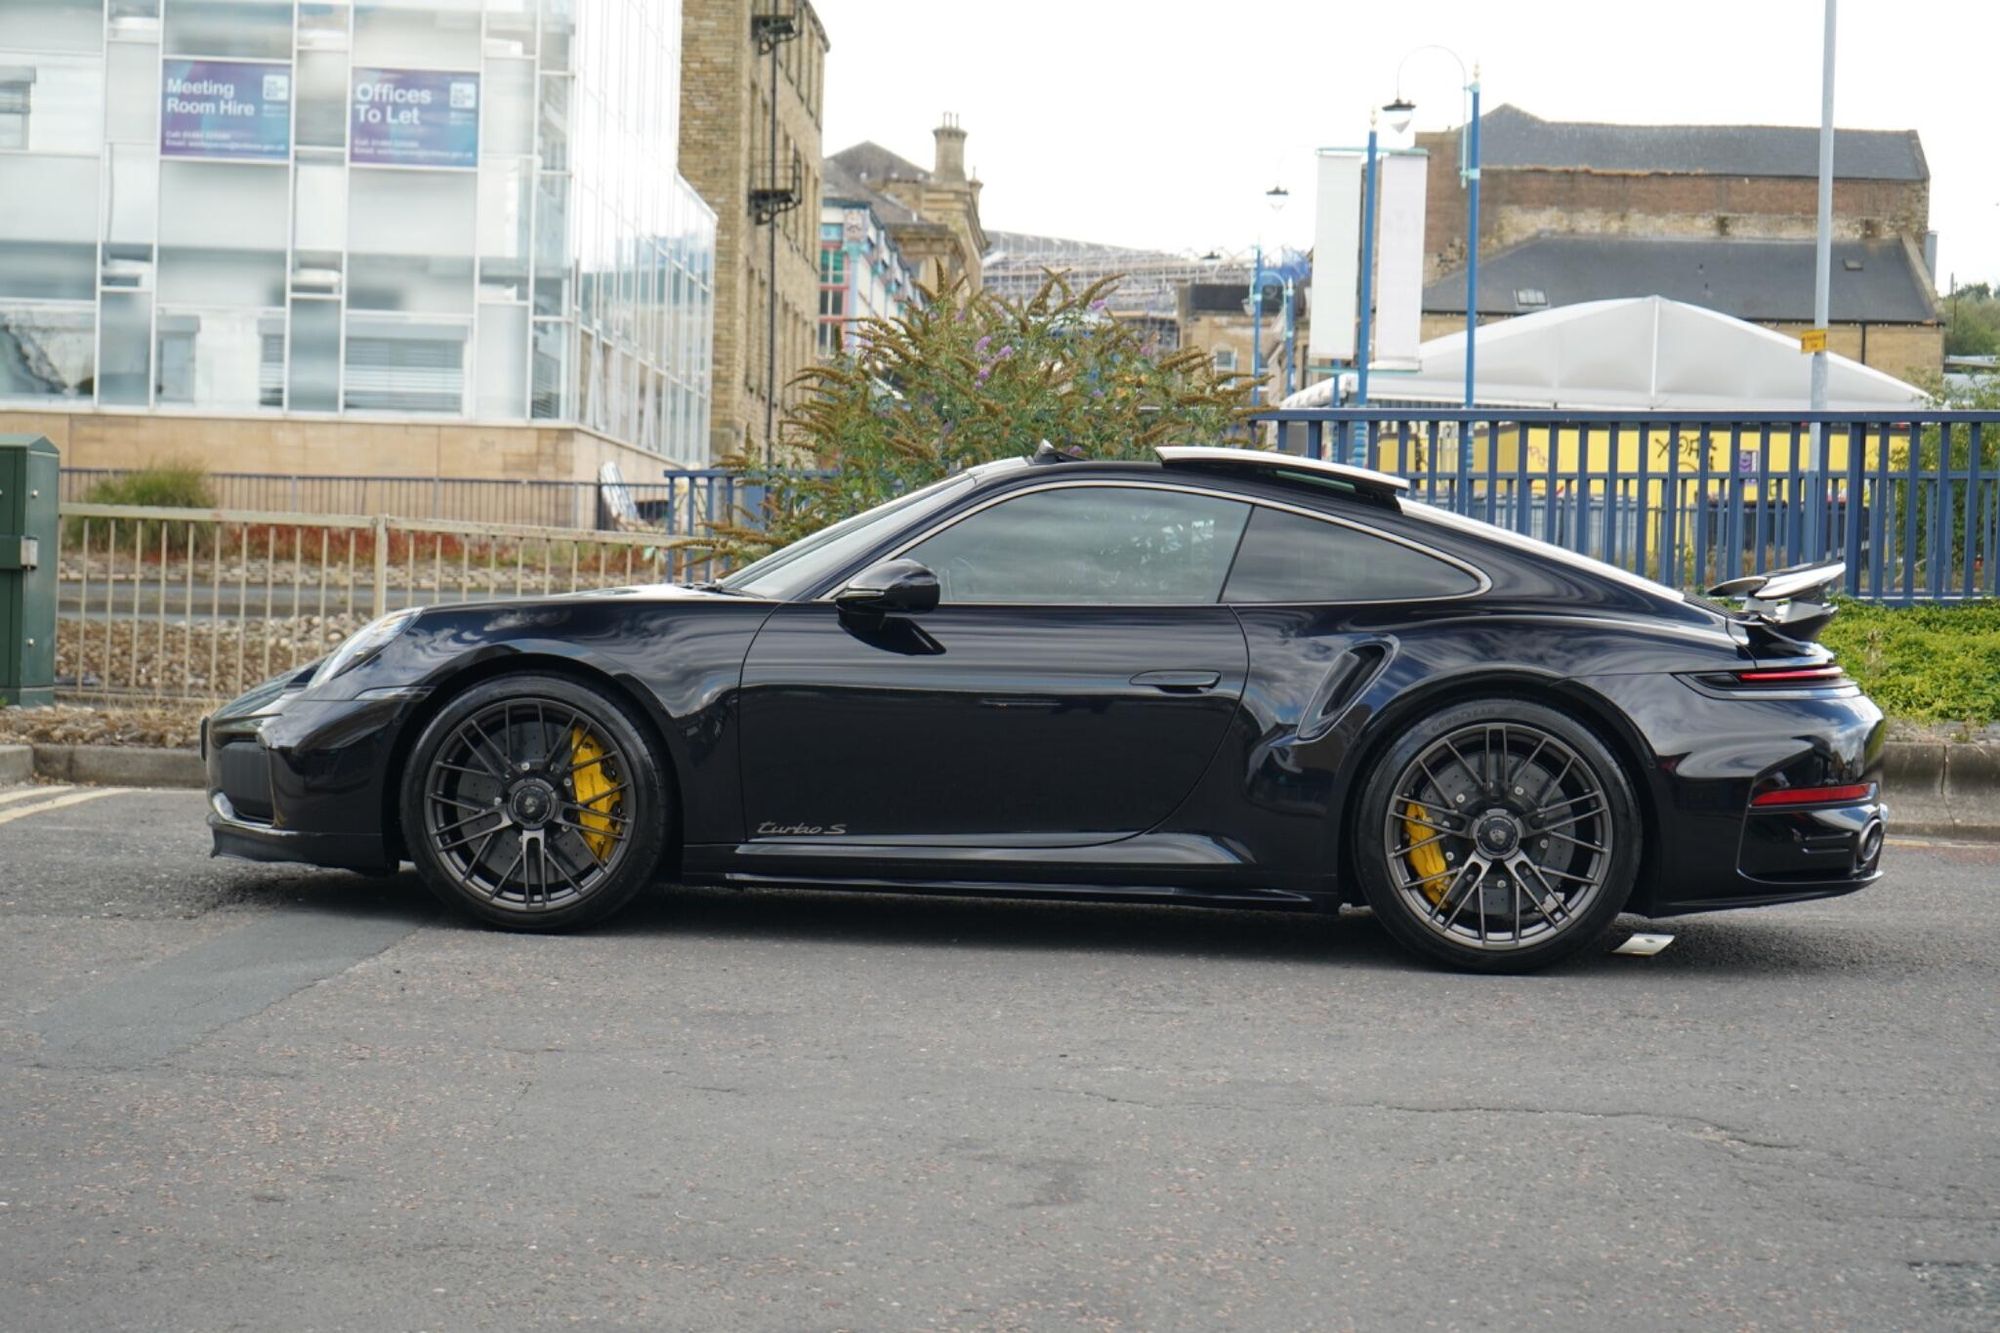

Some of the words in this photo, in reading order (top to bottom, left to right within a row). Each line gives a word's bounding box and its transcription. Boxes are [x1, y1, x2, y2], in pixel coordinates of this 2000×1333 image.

[166, 78, 235, 100] Meeting
[356, 82, 432, 104] Offices
[167, 97, 216, 115] Room
[219, 100, 255, 117] Hire
[355, 104, 382, 123] To
[386, 105, 421, 125] Let
[757, 820, 822, 834] turbo
[823, 823, 848, 834] S
